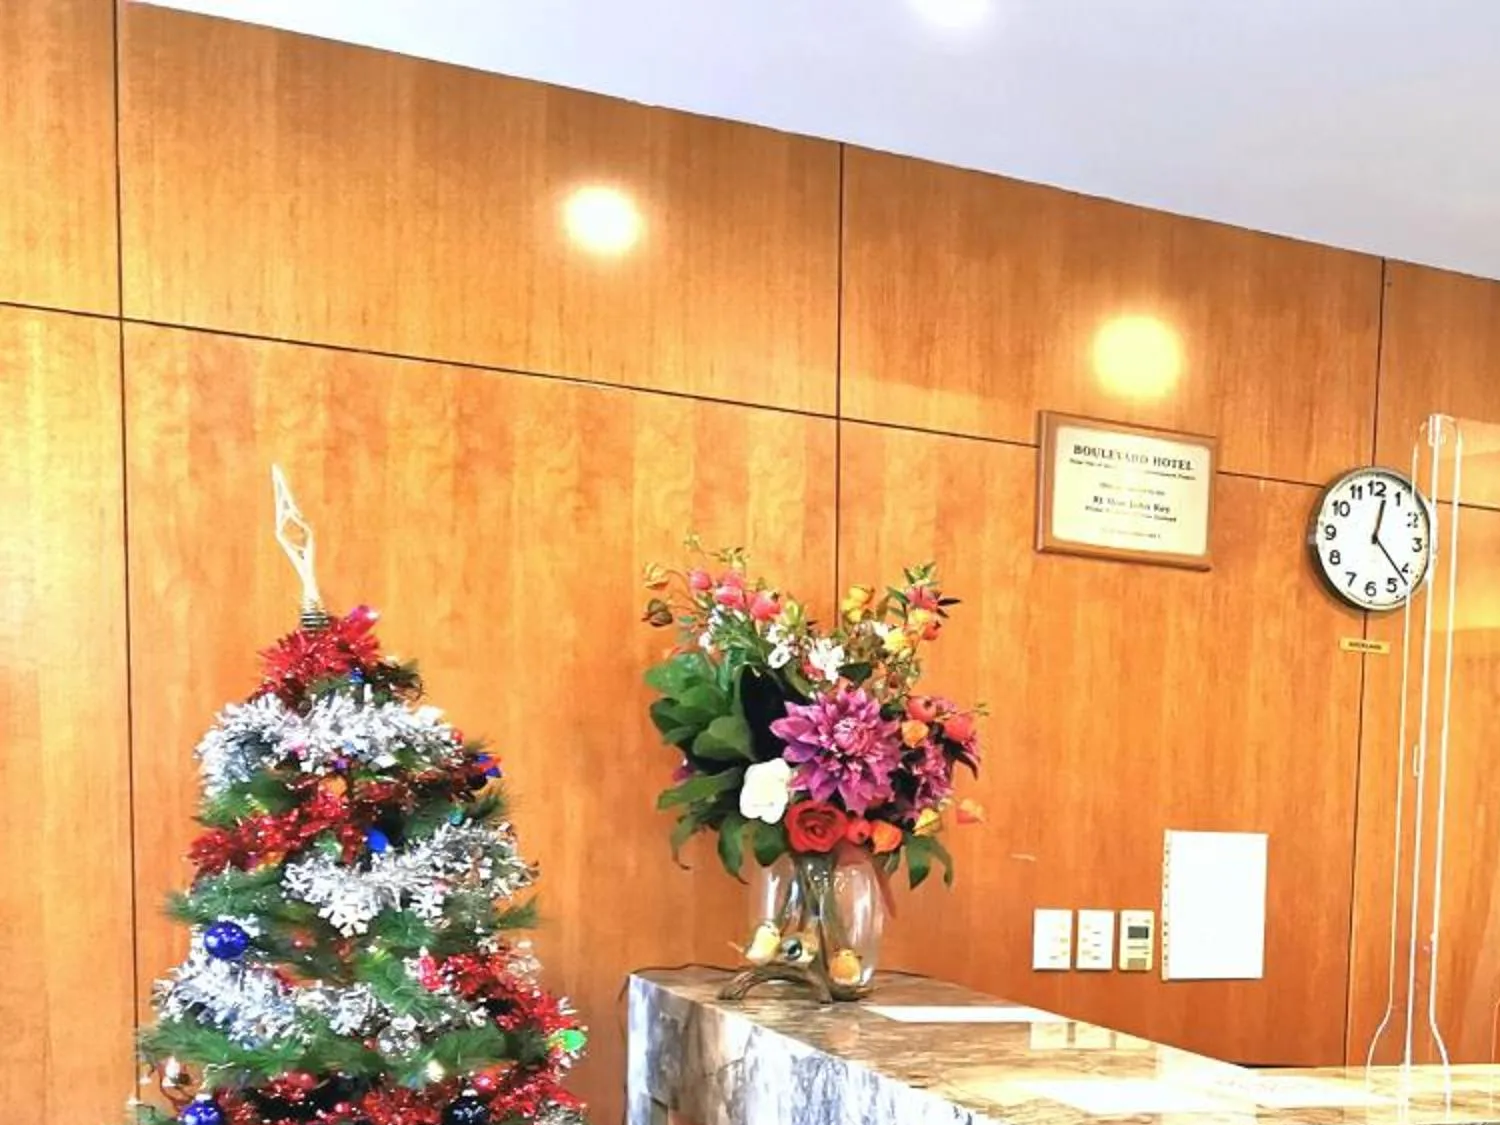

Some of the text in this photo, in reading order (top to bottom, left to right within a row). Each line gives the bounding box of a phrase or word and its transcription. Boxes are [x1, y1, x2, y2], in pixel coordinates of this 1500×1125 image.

[1153, 455, 1195, 471] HOTEL
[1349, 484, 1363, 500] 11
[1368, 480, 1386, 498] 12
[1395, 492, 1401, 507] 1
[1332, 500, 1351, 517] 10
[1325, 524, 1337, 541] 9
[1412, 537, 1423, 553] 3
[1329, 549, 1341, 565] 8
[1345, 571, 1357, 587] 7
[1386, 577, 1398, 593] 5
[1364, 581, 1377, 597] 6
